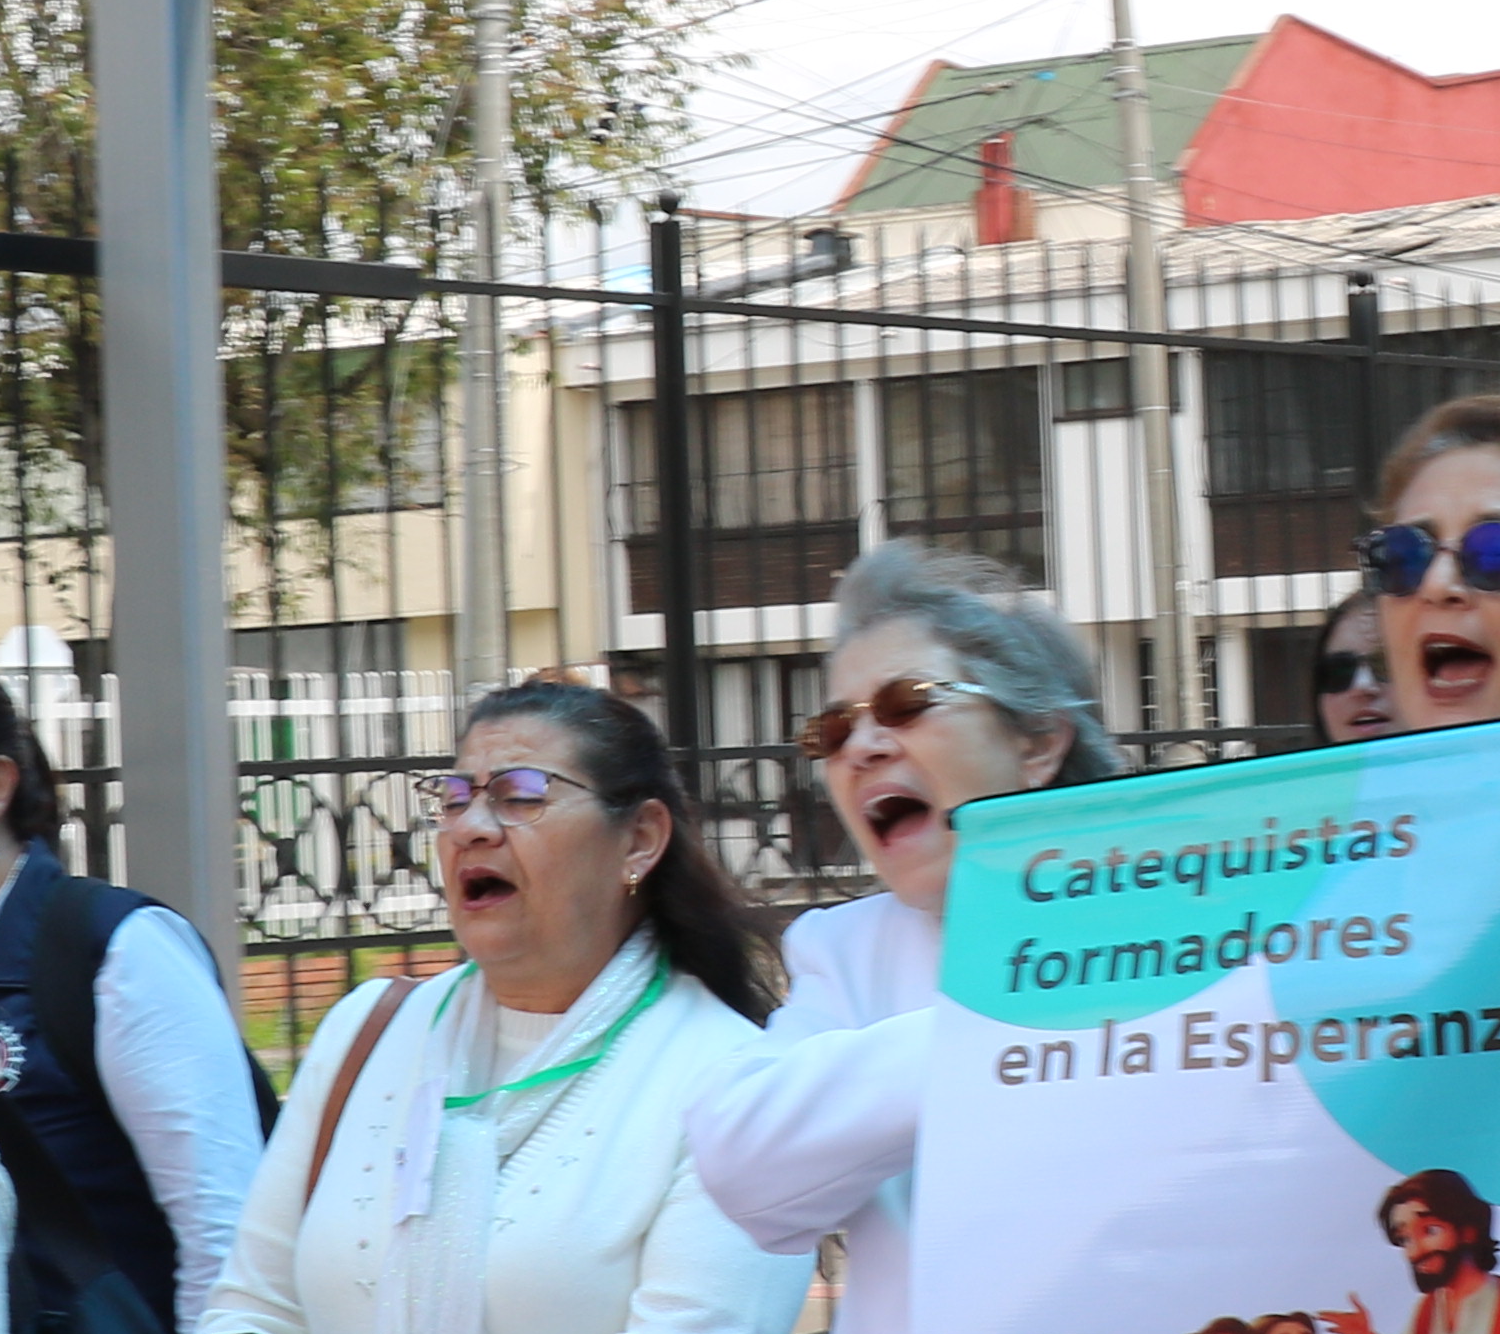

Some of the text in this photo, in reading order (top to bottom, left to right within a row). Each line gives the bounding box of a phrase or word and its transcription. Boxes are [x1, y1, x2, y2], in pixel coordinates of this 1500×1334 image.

[1021, 813, 1419, 903] Catequistas
[1007, 910, 1413, 993] formadores
[993, 1037, 1078, 1086] en
[1098, 1019, 1157, 1076] la
